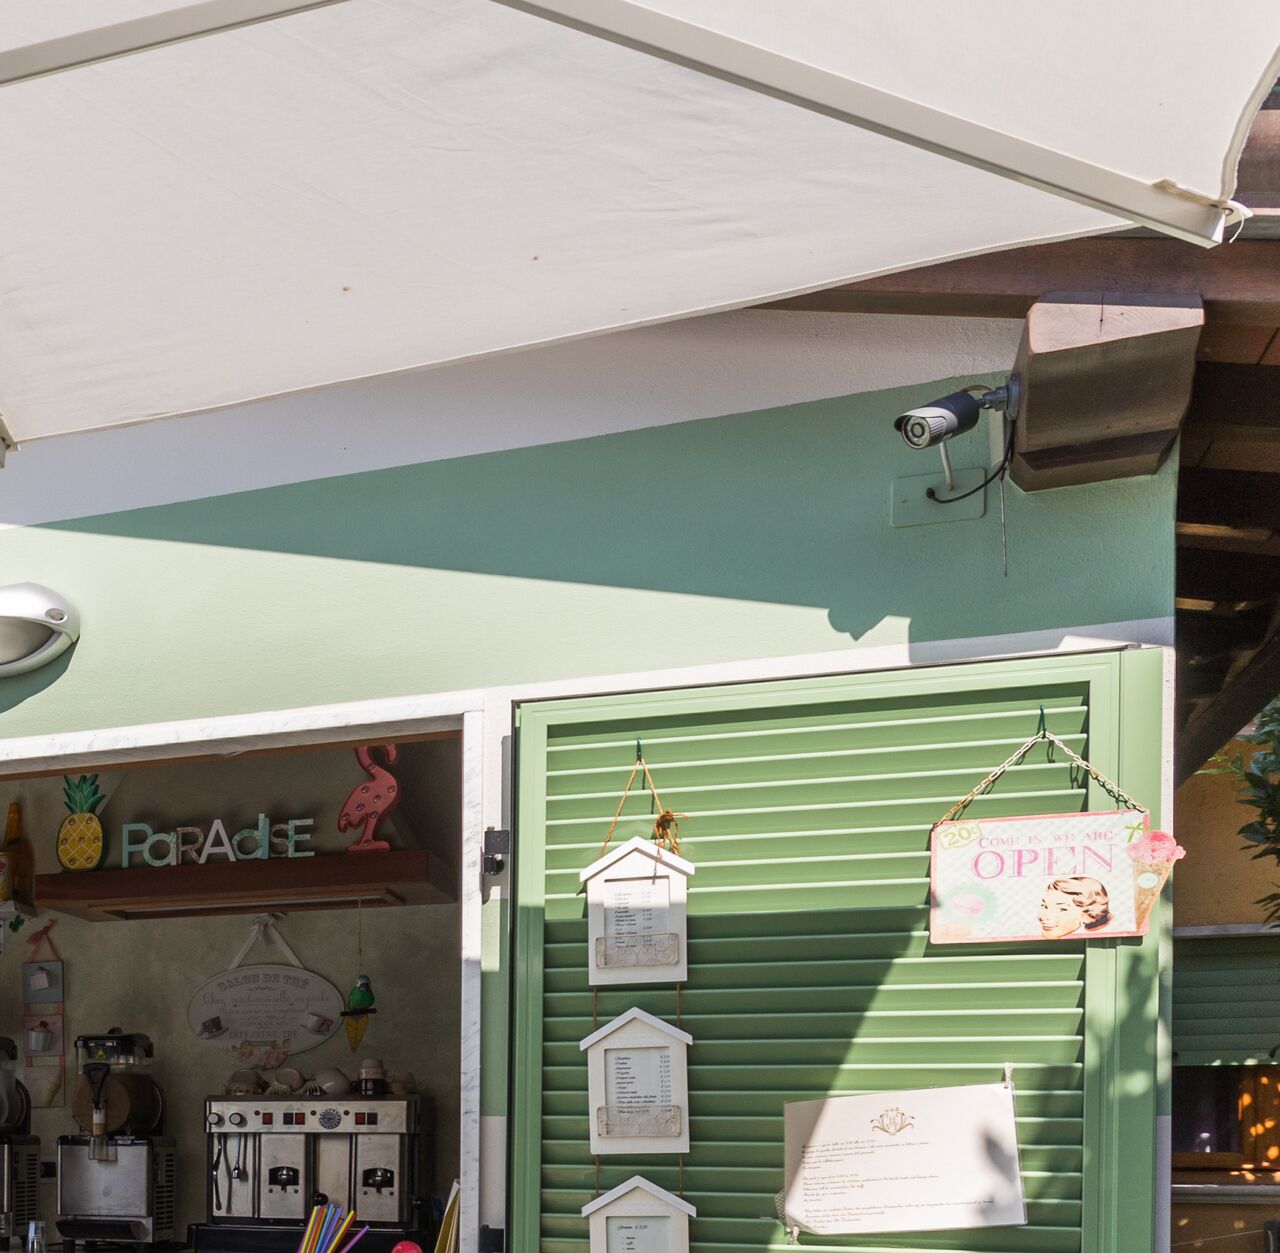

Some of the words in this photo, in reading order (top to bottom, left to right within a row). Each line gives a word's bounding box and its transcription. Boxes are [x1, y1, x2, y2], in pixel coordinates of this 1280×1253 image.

[979, 836, 1020, 848] COME
[1028, 834, 1042, 846] IN
[1053, 832, 1077, 843] WE
[1084, 830, 1114, 842] ARE
[970, 843, 1117, 880] OPEN
[216, 973, 260, 992] SALON
[262, 973, 281, 984] DE
